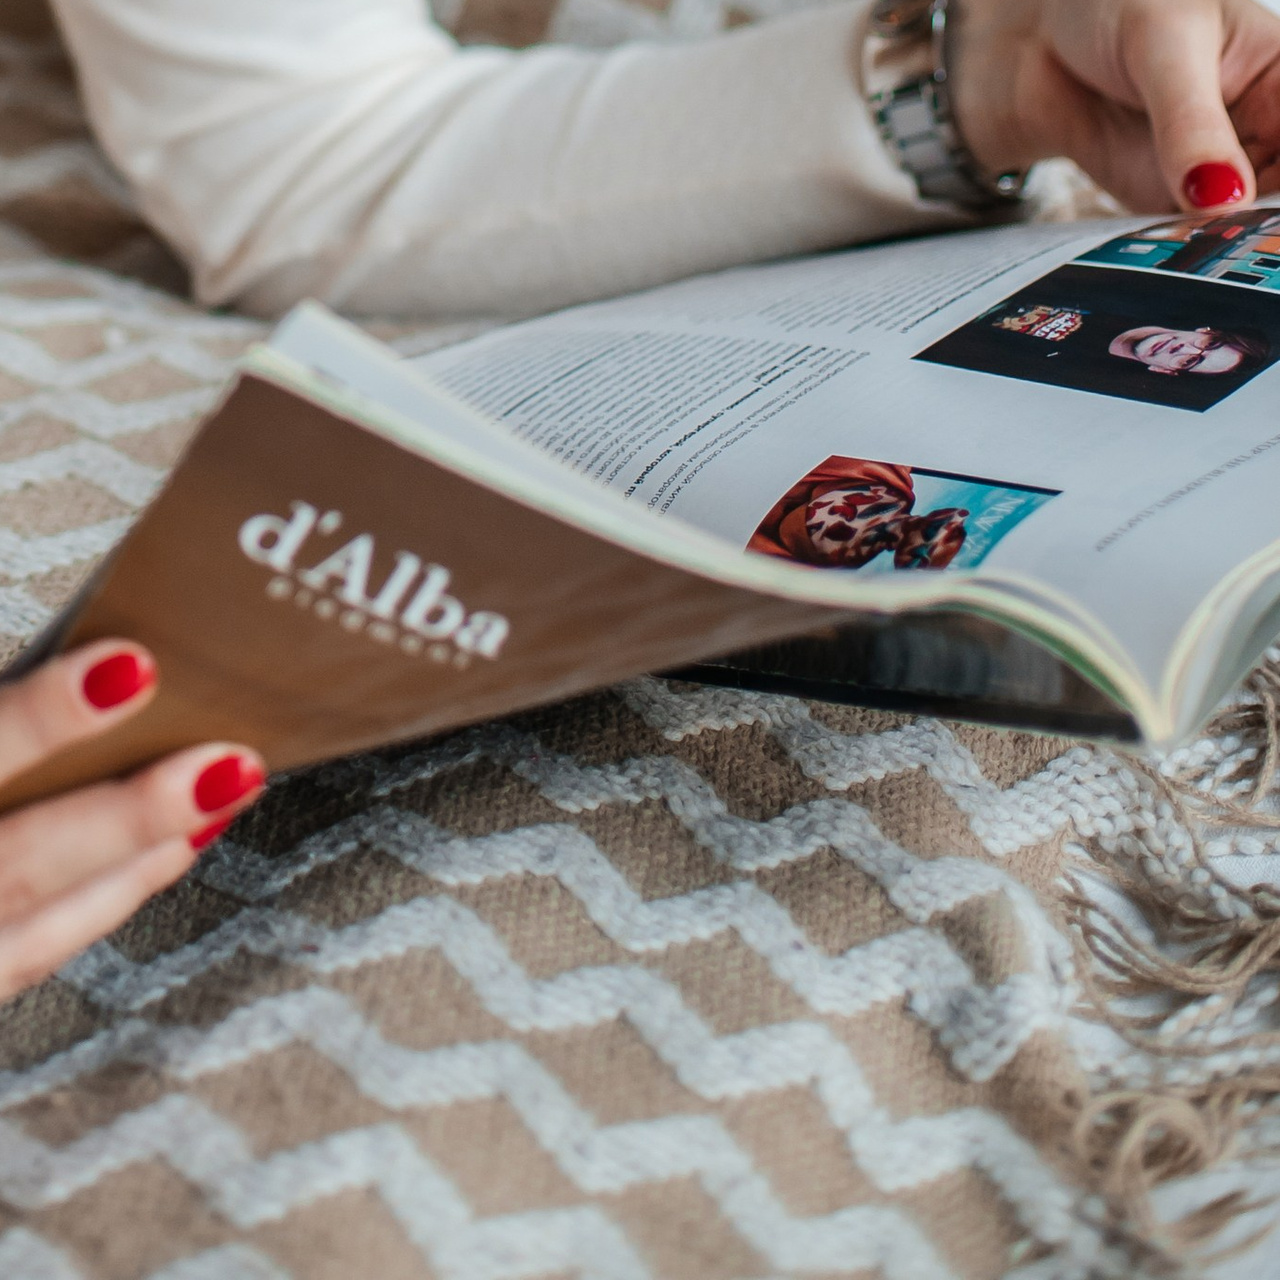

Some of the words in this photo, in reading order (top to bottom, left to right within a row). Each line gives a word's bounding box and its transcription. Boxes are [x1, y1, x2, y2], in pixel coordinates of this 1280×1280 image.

[603, 450, 635, 485] остаютс
[633, 448, 673, 486] который
[648, 462, 686, 507] декоратор
[681, 449, 723, 485] сельской
[661, 484, 682, 513] жител
[237, 499, 511, 662] d'Alba
